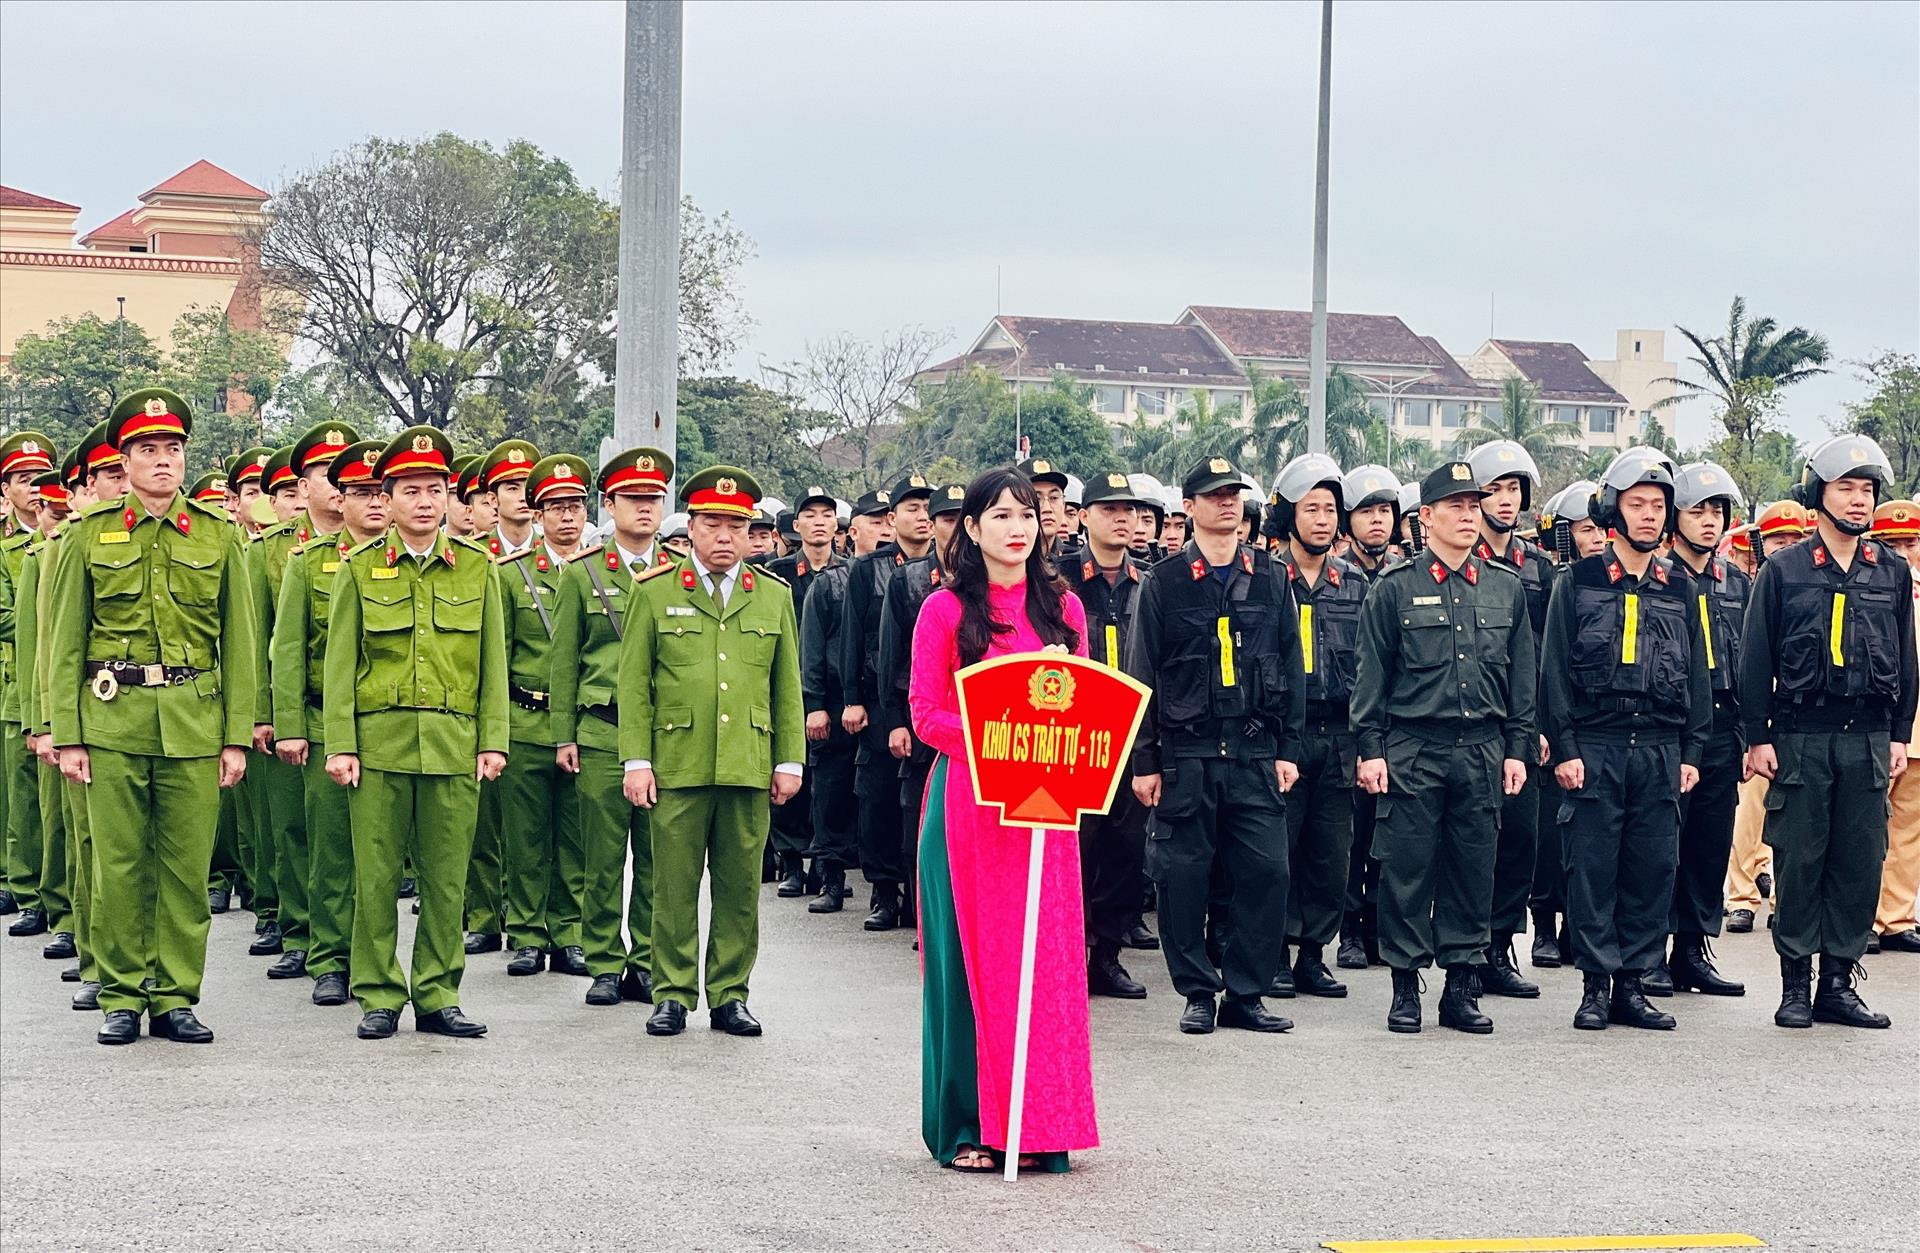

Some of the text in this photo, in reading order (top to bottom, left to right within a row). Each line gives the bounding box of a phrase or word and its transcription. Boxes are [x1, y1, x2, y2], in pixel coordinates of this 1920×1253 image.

[982, 707, 1011, 761] KHỐI
[1012, 722, 1031, 763] CS
[1032, 717, 1063, 773] TRẬT
[1064, 723, 1082, 774] TỰ
[1089, 730, 1111, 769] 113
